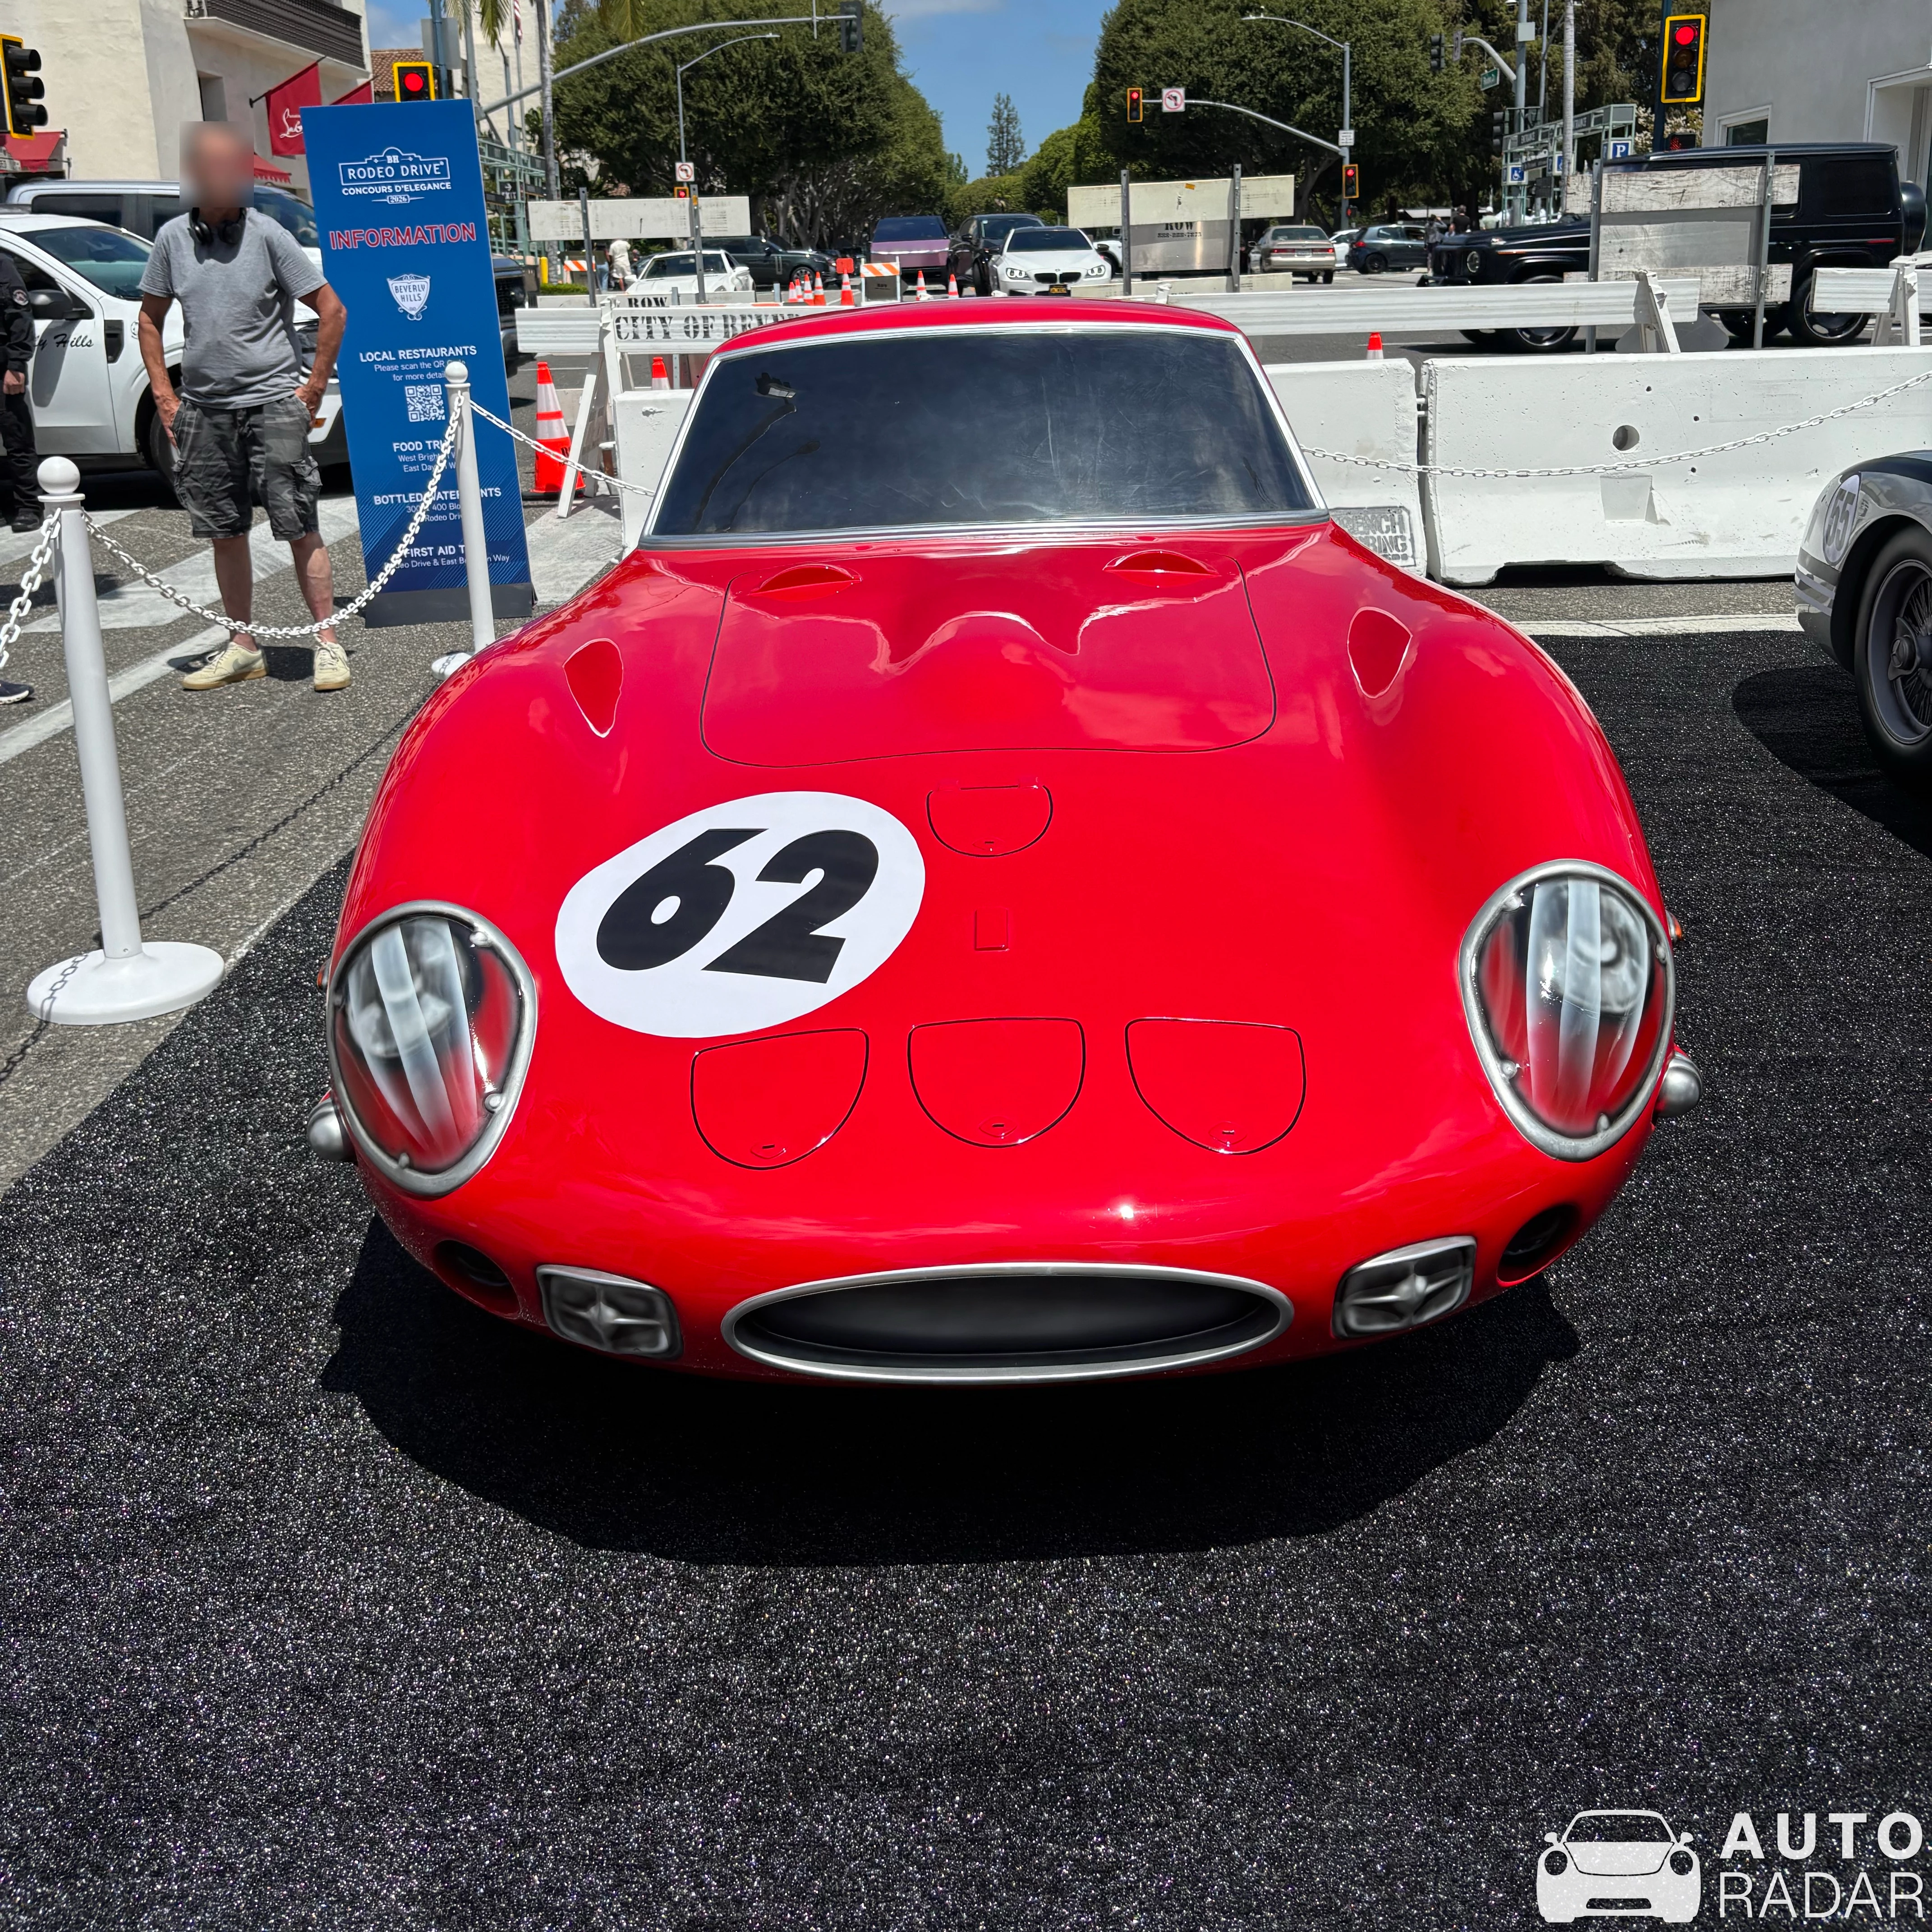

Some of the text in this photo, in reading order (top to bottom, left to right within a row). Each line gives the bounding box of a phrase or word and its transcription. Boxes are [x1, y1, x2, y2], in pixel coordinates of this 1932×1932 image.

[1616, 145, 1626, 157] P
[386, 155, 399, 163] BH
[348, 166, 394, 179] RODEO
[342, 182, 451, 195] CONCOURS D'ELEGANCE
[329, 223, 476, 249] INFORMATION
[395, 285, 425, 293] BEVERLY
[401, 294, 422, 302] HILLS
[627, 297, 667, 307] ROW
[615, 316, 673, 340] CITY
[684, 316, 716, 339] OF
[54, 333, 94, 347] Hills
[359, 346, 477, 362] LOCAL RESTAURANTS
[401, 362, 418, 370] scan
[393, 442, 423, 452] FOOD
[374, 493, 423, 505] BOTTLED
[1826, 488, 1856, 551] 55
[404, 547, 434, 557] FIRST
[437, 545, 455, 555] AID
[411, 559, 431, 567] Drive
[493, 554, 510, 563] Way
[597, 828, 879, 984] 62
